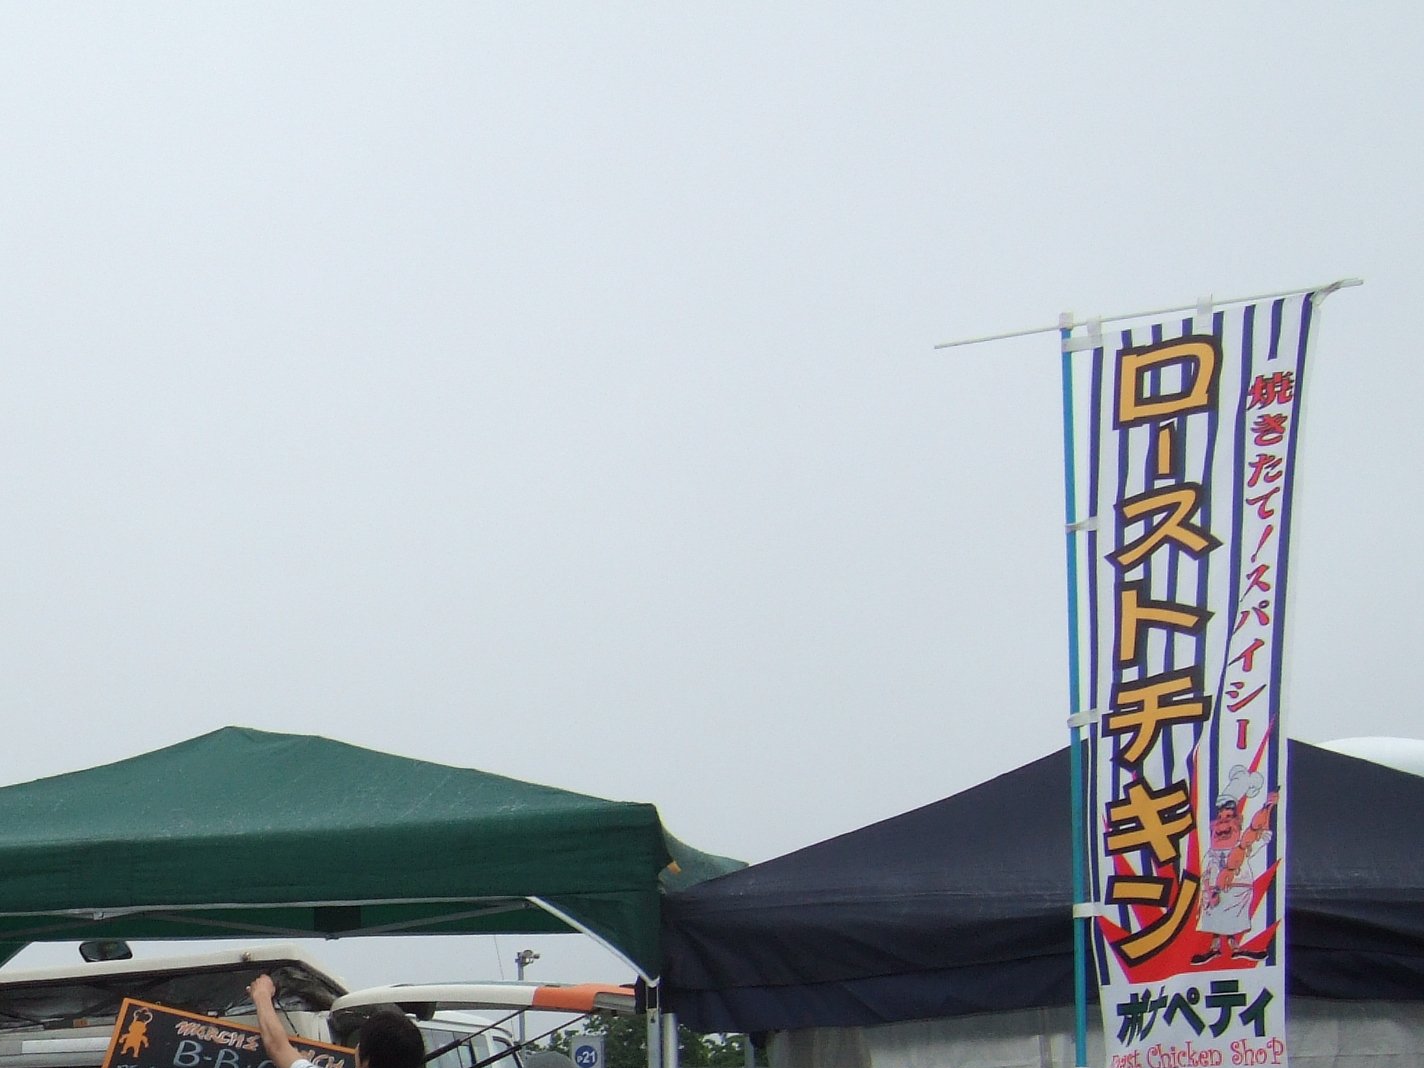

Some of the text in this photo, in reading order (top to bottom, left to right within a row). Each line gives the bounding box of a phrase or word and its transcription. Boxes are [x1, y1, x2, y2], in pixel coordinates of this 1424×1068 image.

[1101, 334, 1224, 968] ローストチキン
